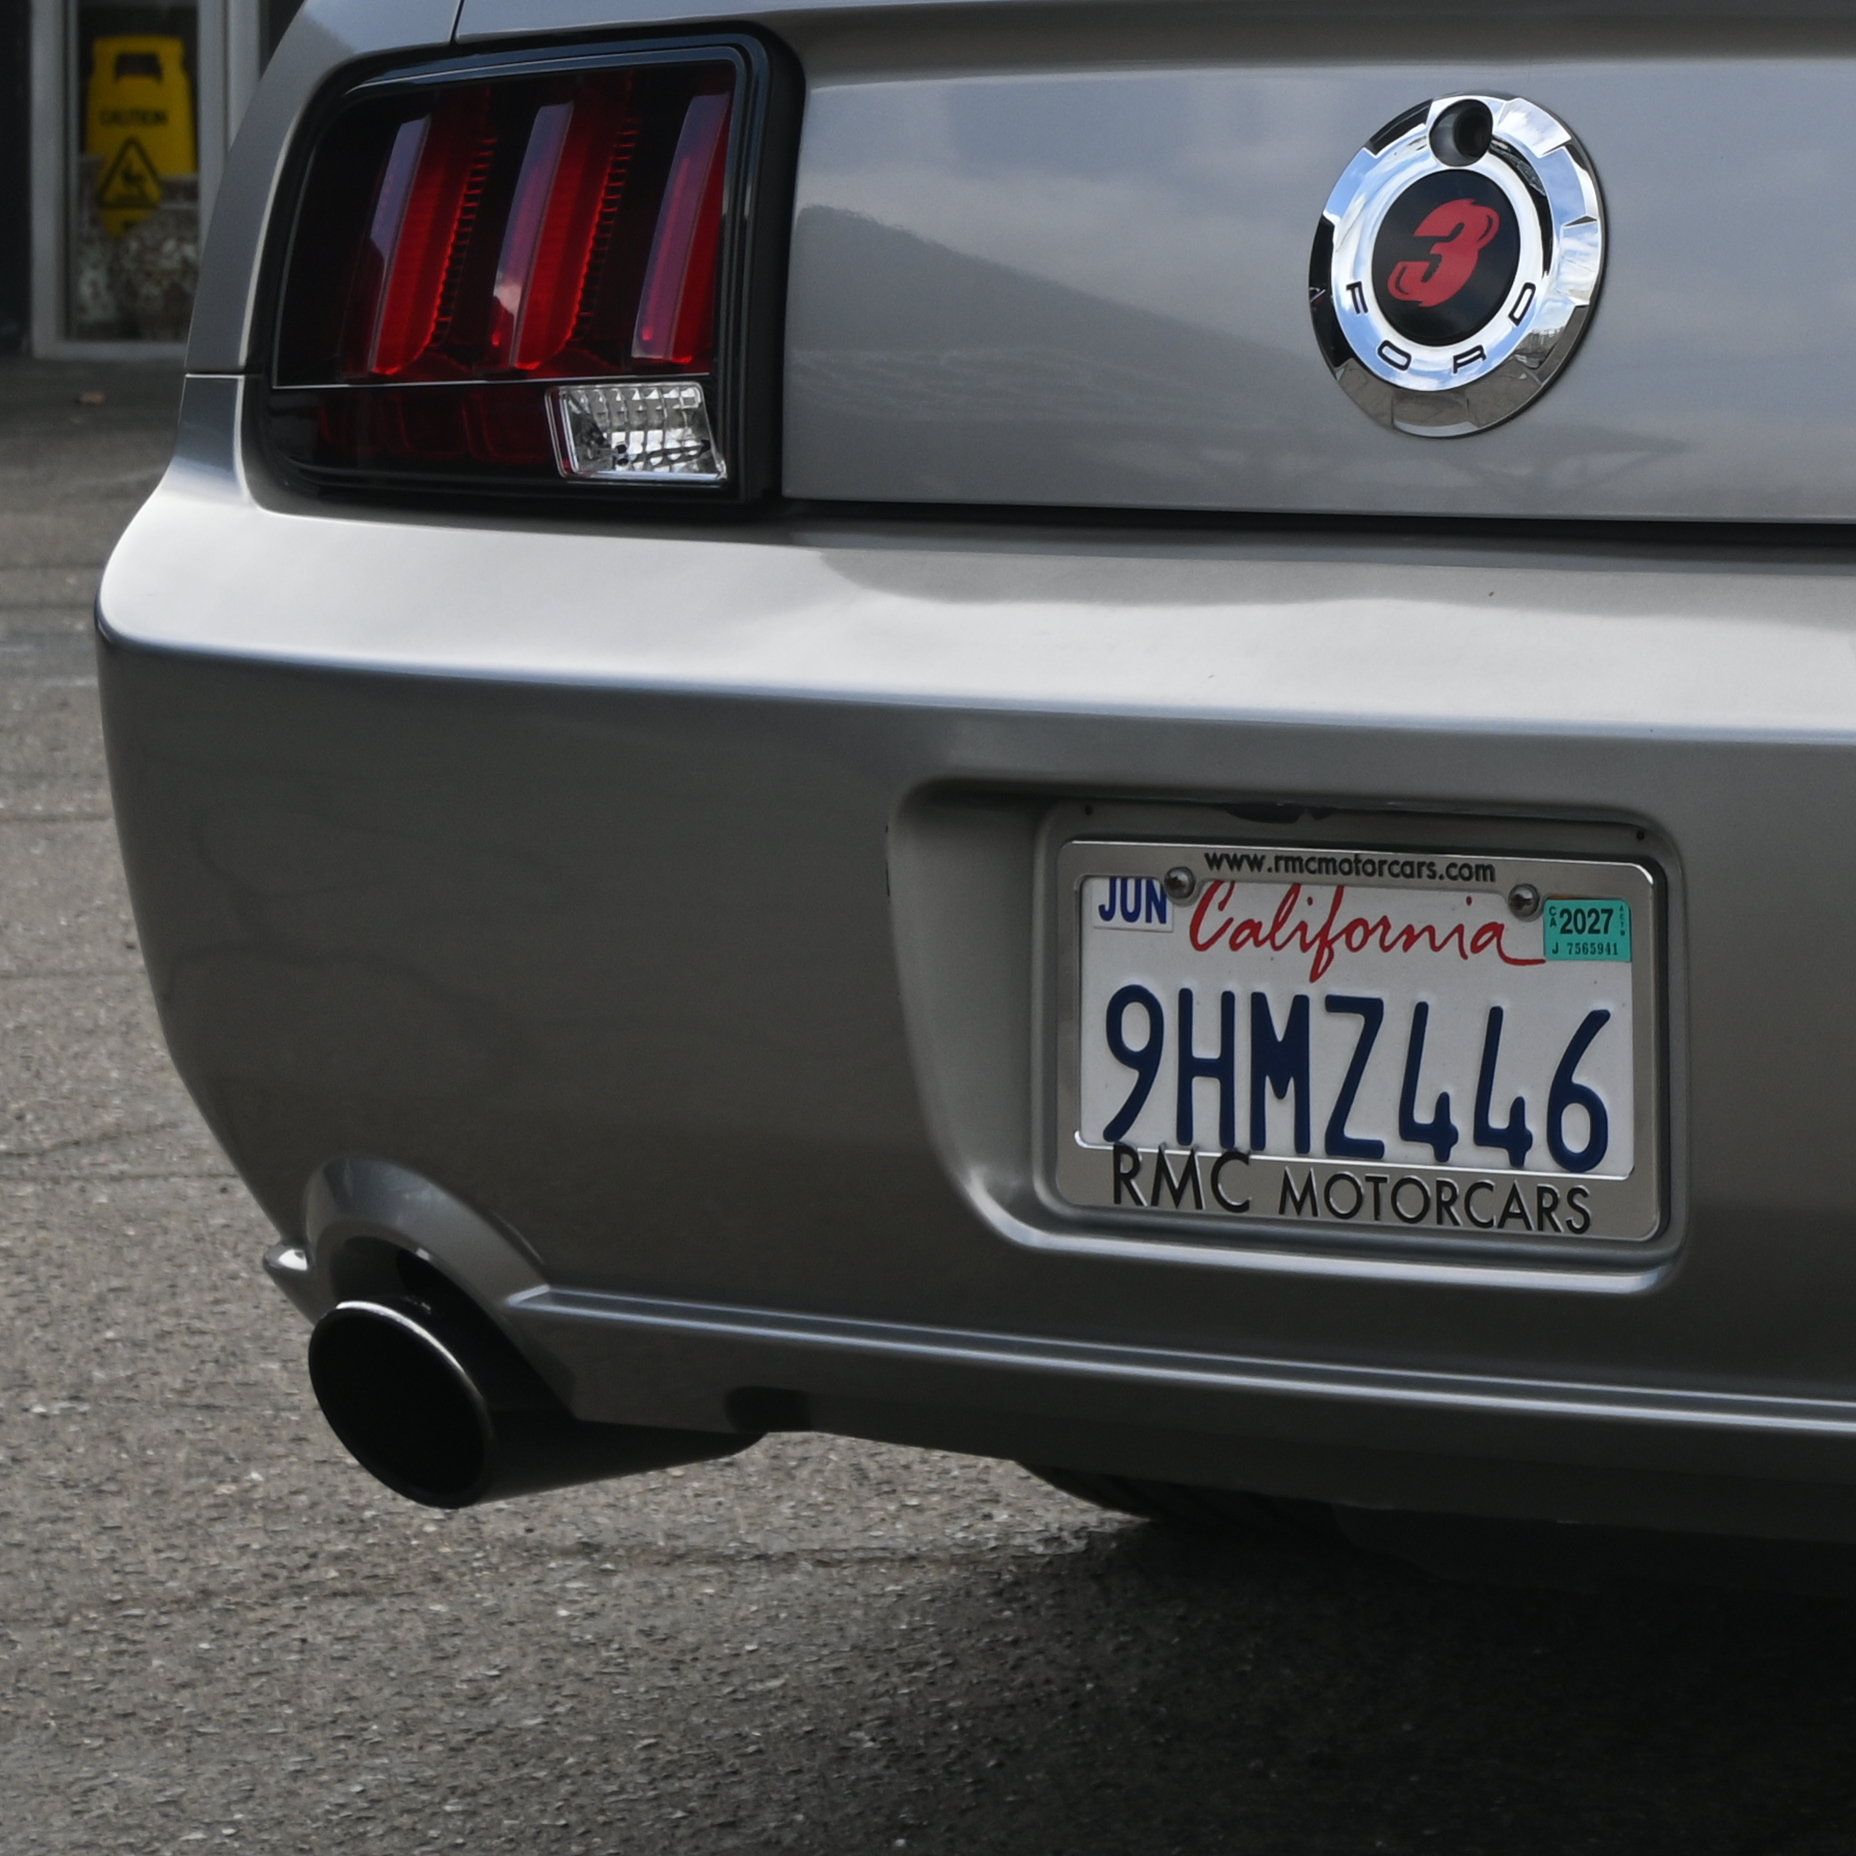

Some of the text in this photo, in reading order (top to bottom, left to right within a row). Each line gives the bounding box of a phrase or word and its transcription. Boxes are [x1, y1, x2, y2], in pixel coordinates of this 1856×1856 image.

[1386, 197, 1503, 309] 3
[1346, 280, 1537, 375] FORD
[1098, 876, 1168, 925] JUN
[1203, 851, 1497, 883] www.rmcmotorcars.com
[1189, 880, 1547, 984] California
[1559, 908, 1614, 935] 2027
[1101, 984, 1611, 1174] 9HMZ446
[1113, 1142, 1592, 1235] RMC MOTORCARS
